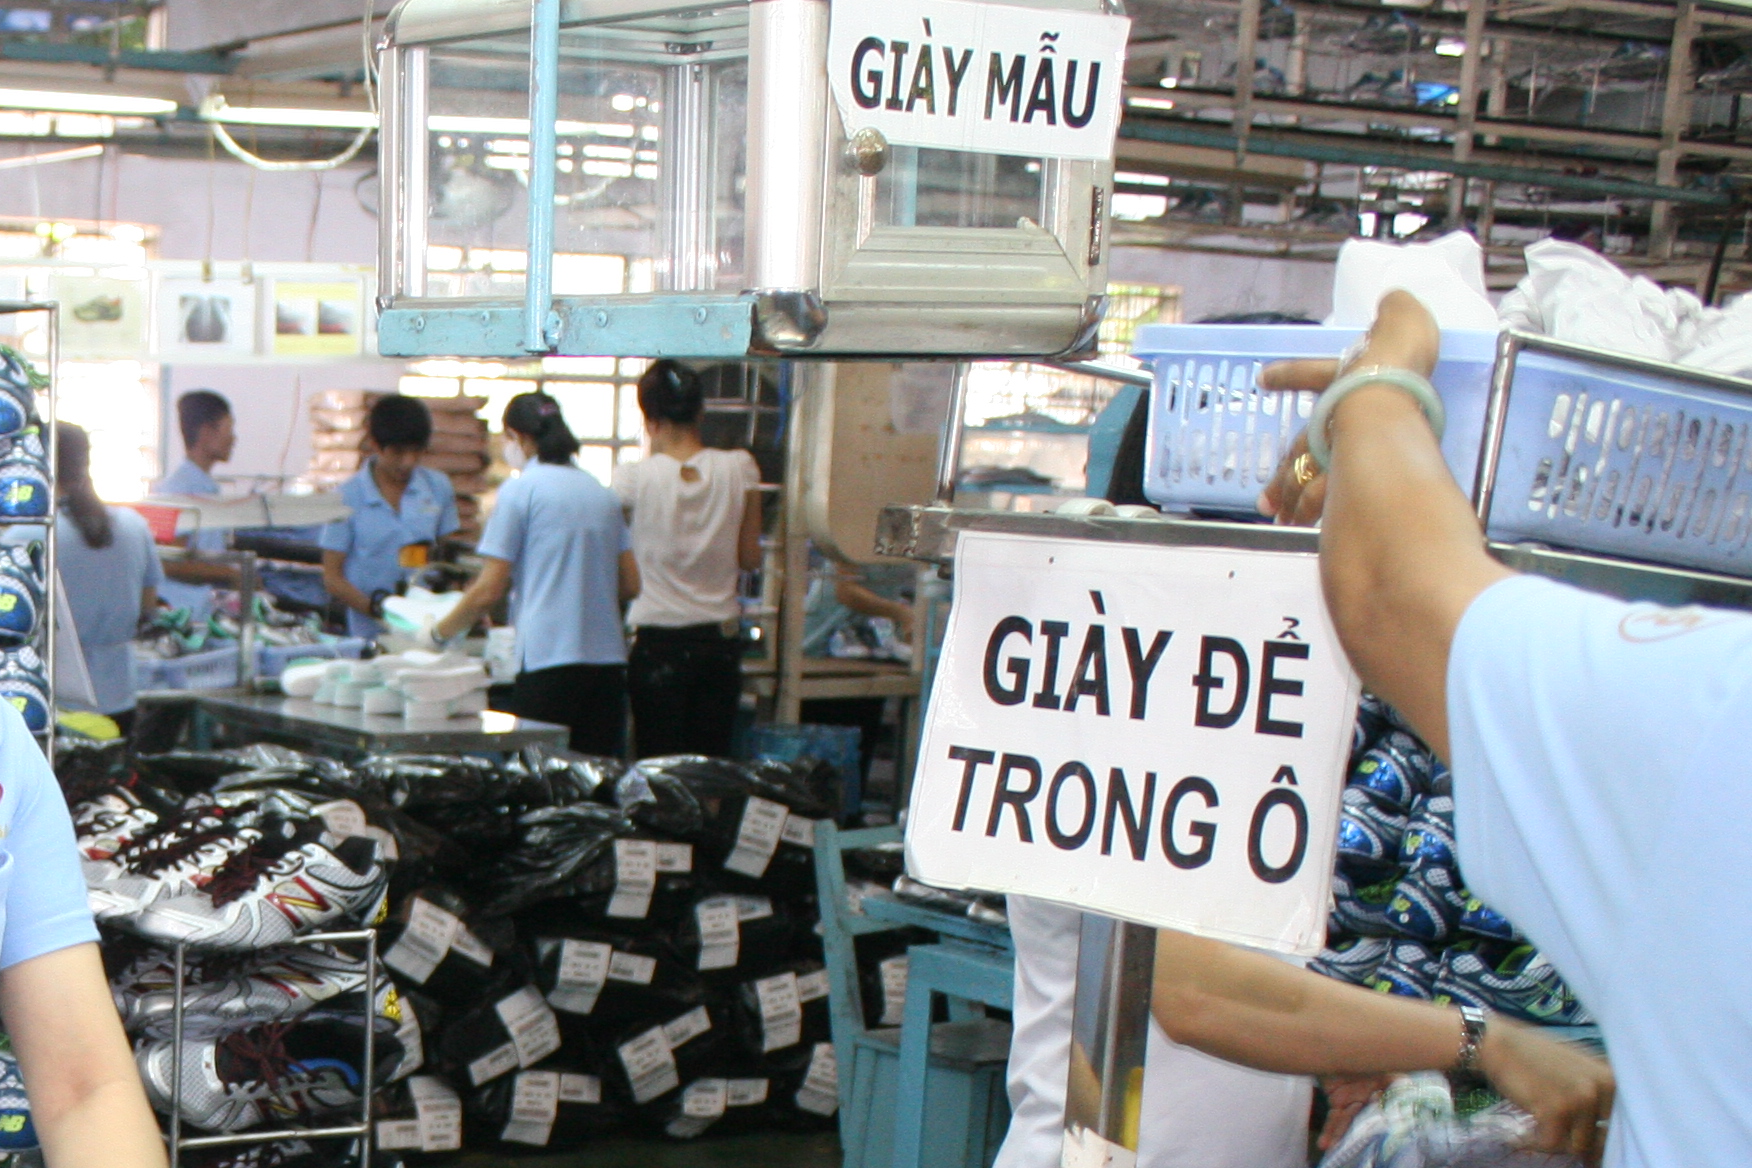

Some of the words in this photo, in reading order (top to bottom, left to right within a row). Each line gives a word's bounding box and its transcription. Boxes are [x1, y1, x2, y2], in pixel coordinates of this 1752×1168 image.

[850, 18, 973, 117] GIÀY
[984, 31, 1100, 129] MẪU
[983, 590, 1173, 720] GIÀY
[1192, 616, 1310, 738] ĐỂ
[948, 745, 1219, 870] TRONG
[1247, 766, 1309, 884] Ô
